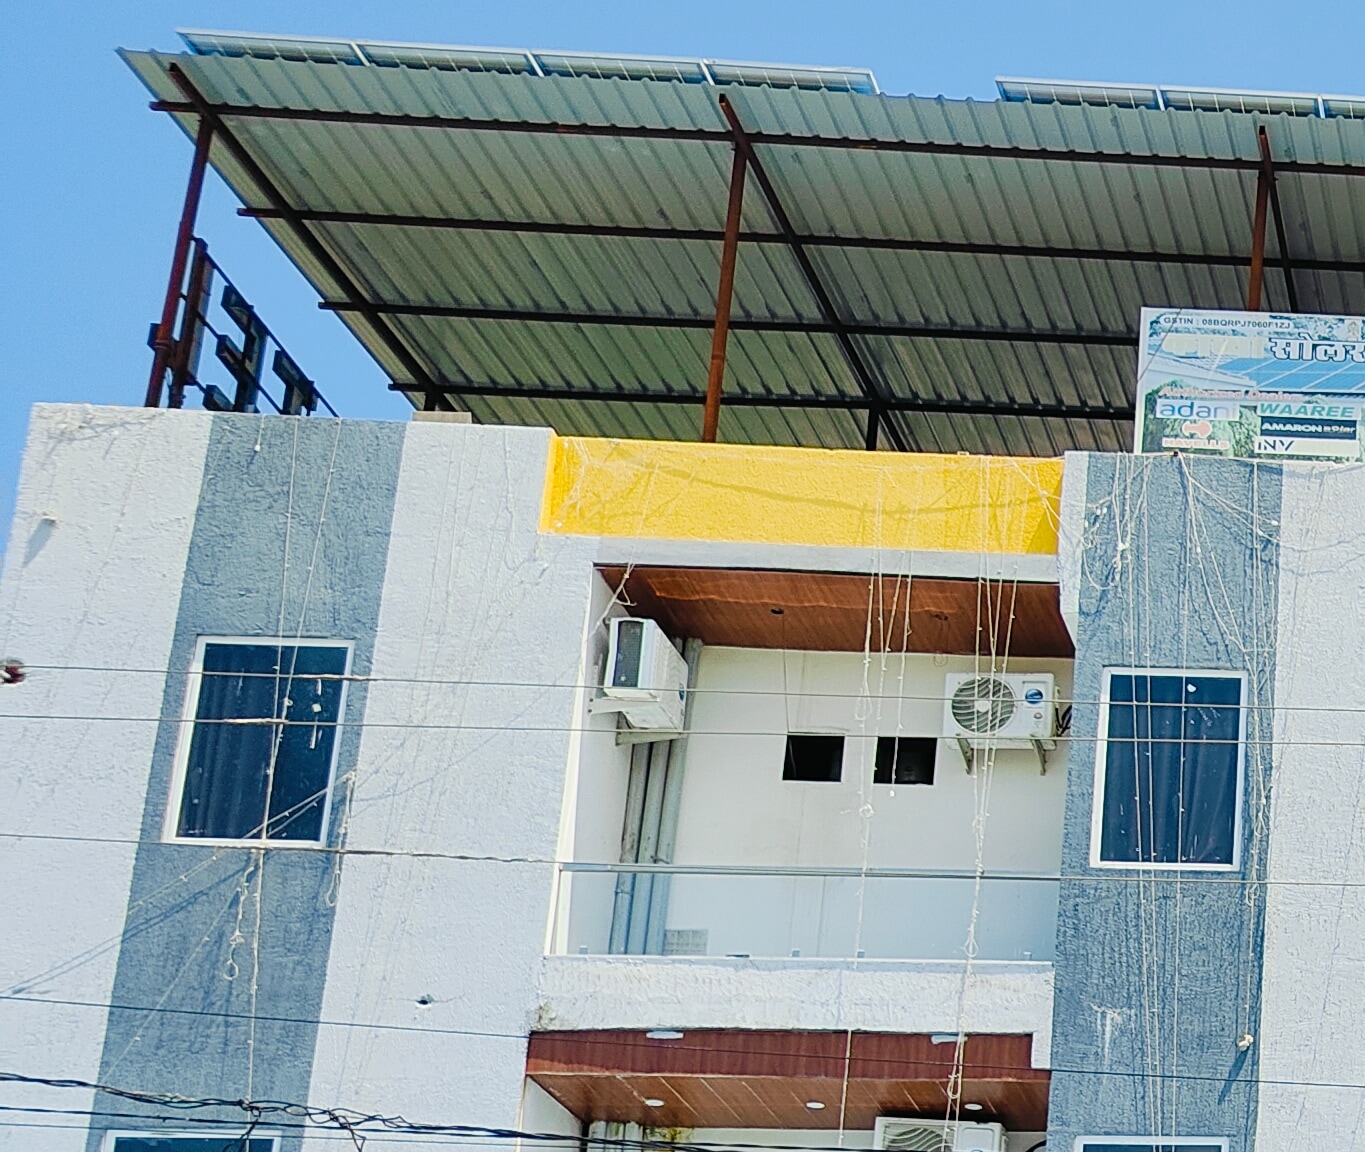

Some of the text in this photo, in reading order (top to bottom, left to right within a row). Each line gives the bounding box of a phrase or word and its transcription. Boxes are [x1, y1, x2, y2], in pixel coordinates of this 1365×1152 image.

[1163, 316, 1194, 325] GSTIN
[1159, 402, 1237, 418] adani
[1260, 403, 1355, 418] WAAREE
[1262, 423, 1322, 434] AMARON
[1162, 438, 1230, 449] HAVELLS
